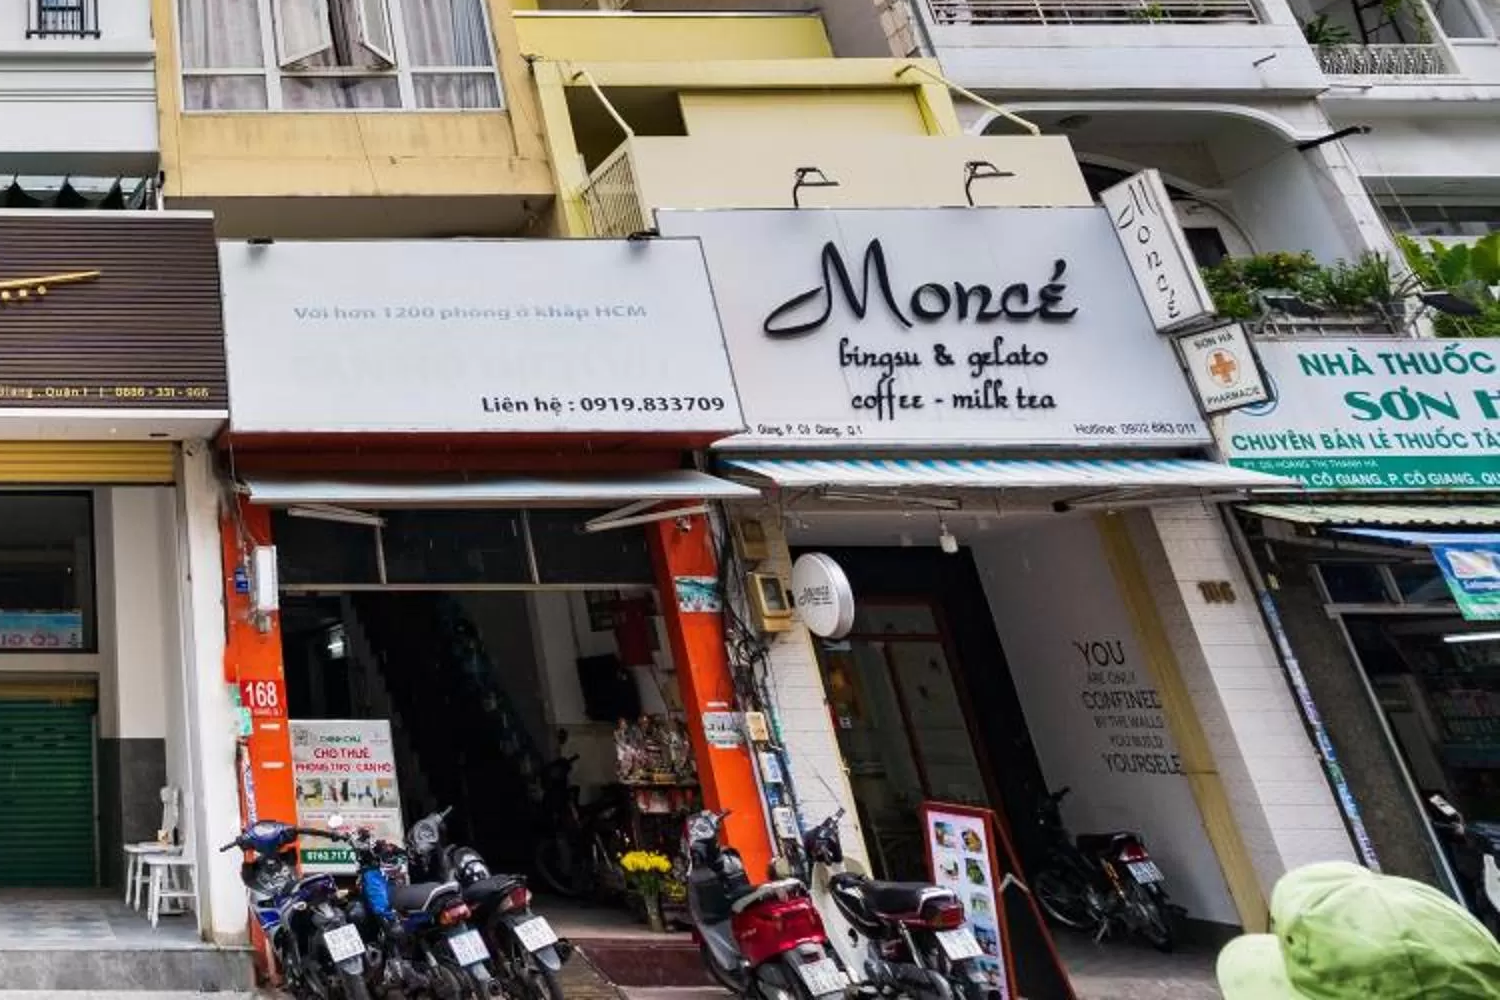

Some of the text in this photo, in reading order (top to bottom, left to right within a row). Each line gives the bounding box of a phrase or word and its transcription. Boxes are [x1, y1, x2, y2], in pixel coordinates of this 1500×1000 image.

[764, 237, 1080, 340] Moncé
[384, 306, 435, 319] 1200
[595, 304, 648, 319] HCM
[839, 335, 1049, 378] bingsu & gelato
[1297, 343, 1496, 377] NHÀ THUỐC
[482, 396, 529, 412] Liên
[534, 396, 563, 416] hệ
[580, 397, 725, 412] 0919.833709
[851, 377, 925, 421] coffee
[952, 378, 1009, 409] milk
[1016, 385, 1058, 409] tea
[1343, 385, 1461, 421] SƠN
[1231, 429, 1316, 451] CHUYÊN
[1320, 427, 1364, 450] BÁN
[1396, 425, 1469, 449] THUỐC
[1311, 470, 1333, 487] CÔ
[1405, 469, 1427, 487] CÔ
[1072, 639, 1125, 667] YOU
[244, 680, 279, 708] 168
